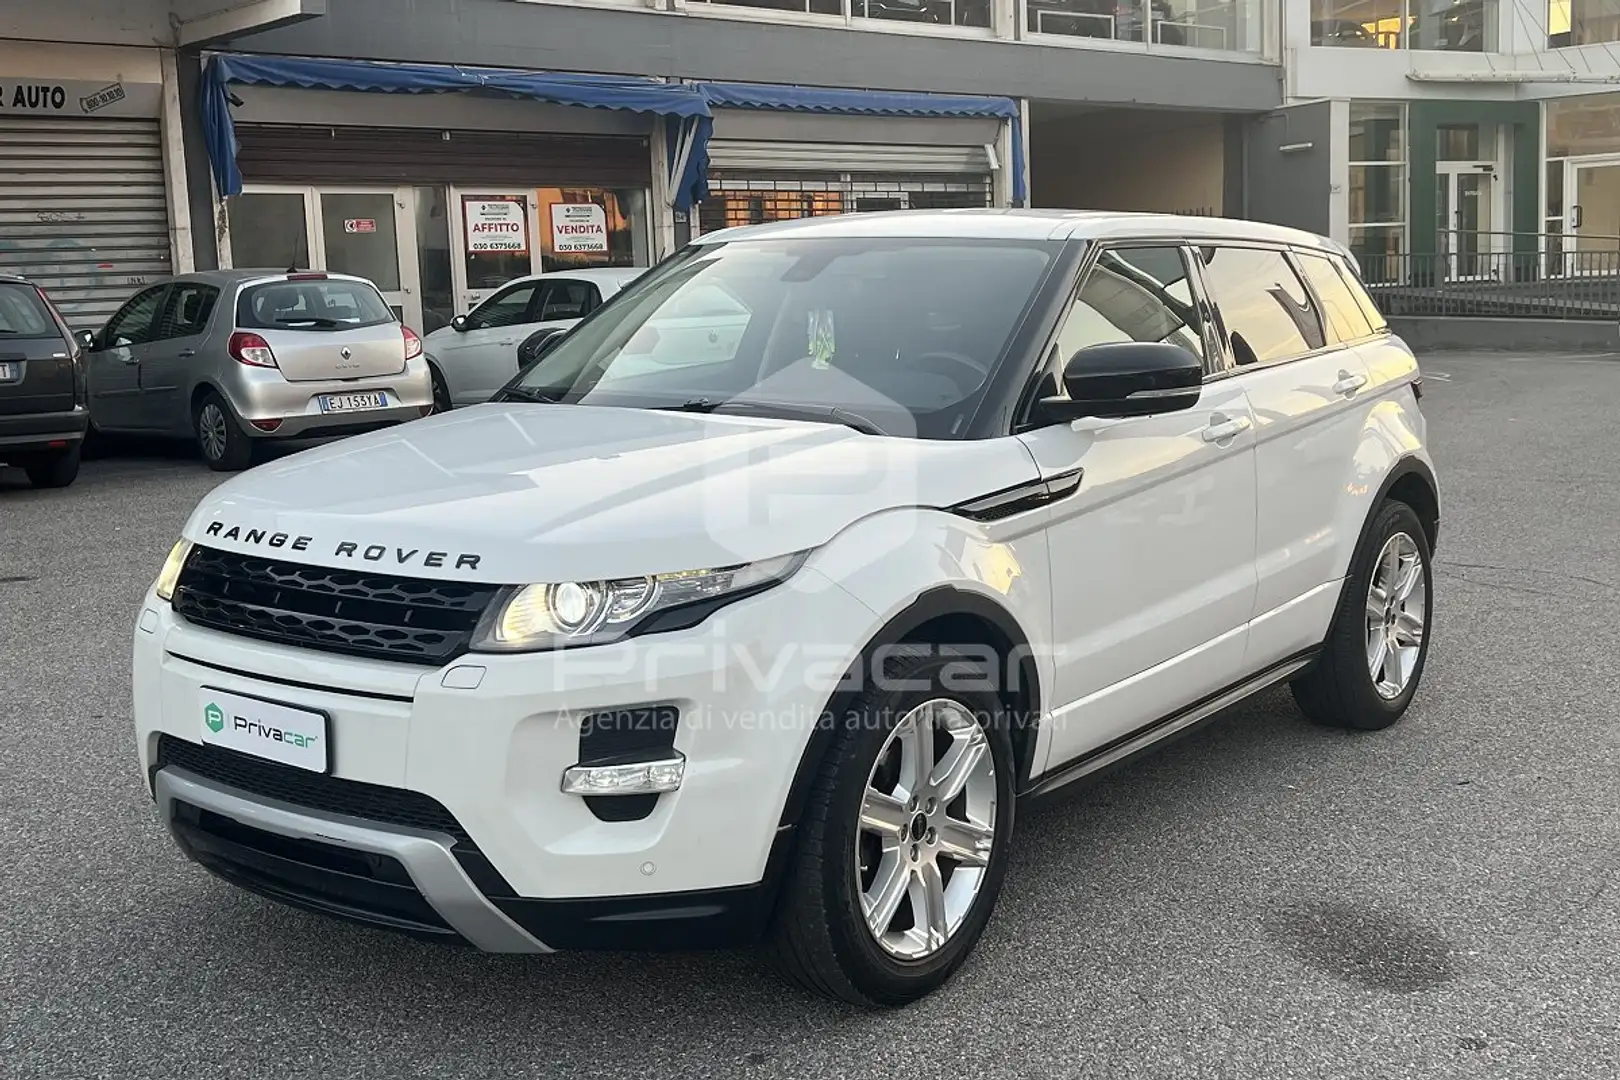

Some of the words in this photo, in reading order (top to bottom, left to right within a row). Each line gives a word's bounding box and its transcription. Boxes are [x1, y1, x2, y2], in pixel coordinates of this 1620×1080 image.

[12, 86, 66, 109] AUTO
[472, 223, 520, 232] AFFITTO
[556, 225, 603, 234] VENDITA
[329, 397, 344, 409] EJ
[347, 394, 381, 408] 153YA
[205, 520, 313, 551] RANGE
[334, 541, 481, 570] ROVER
[233, 715, 315, 749] Privacar
